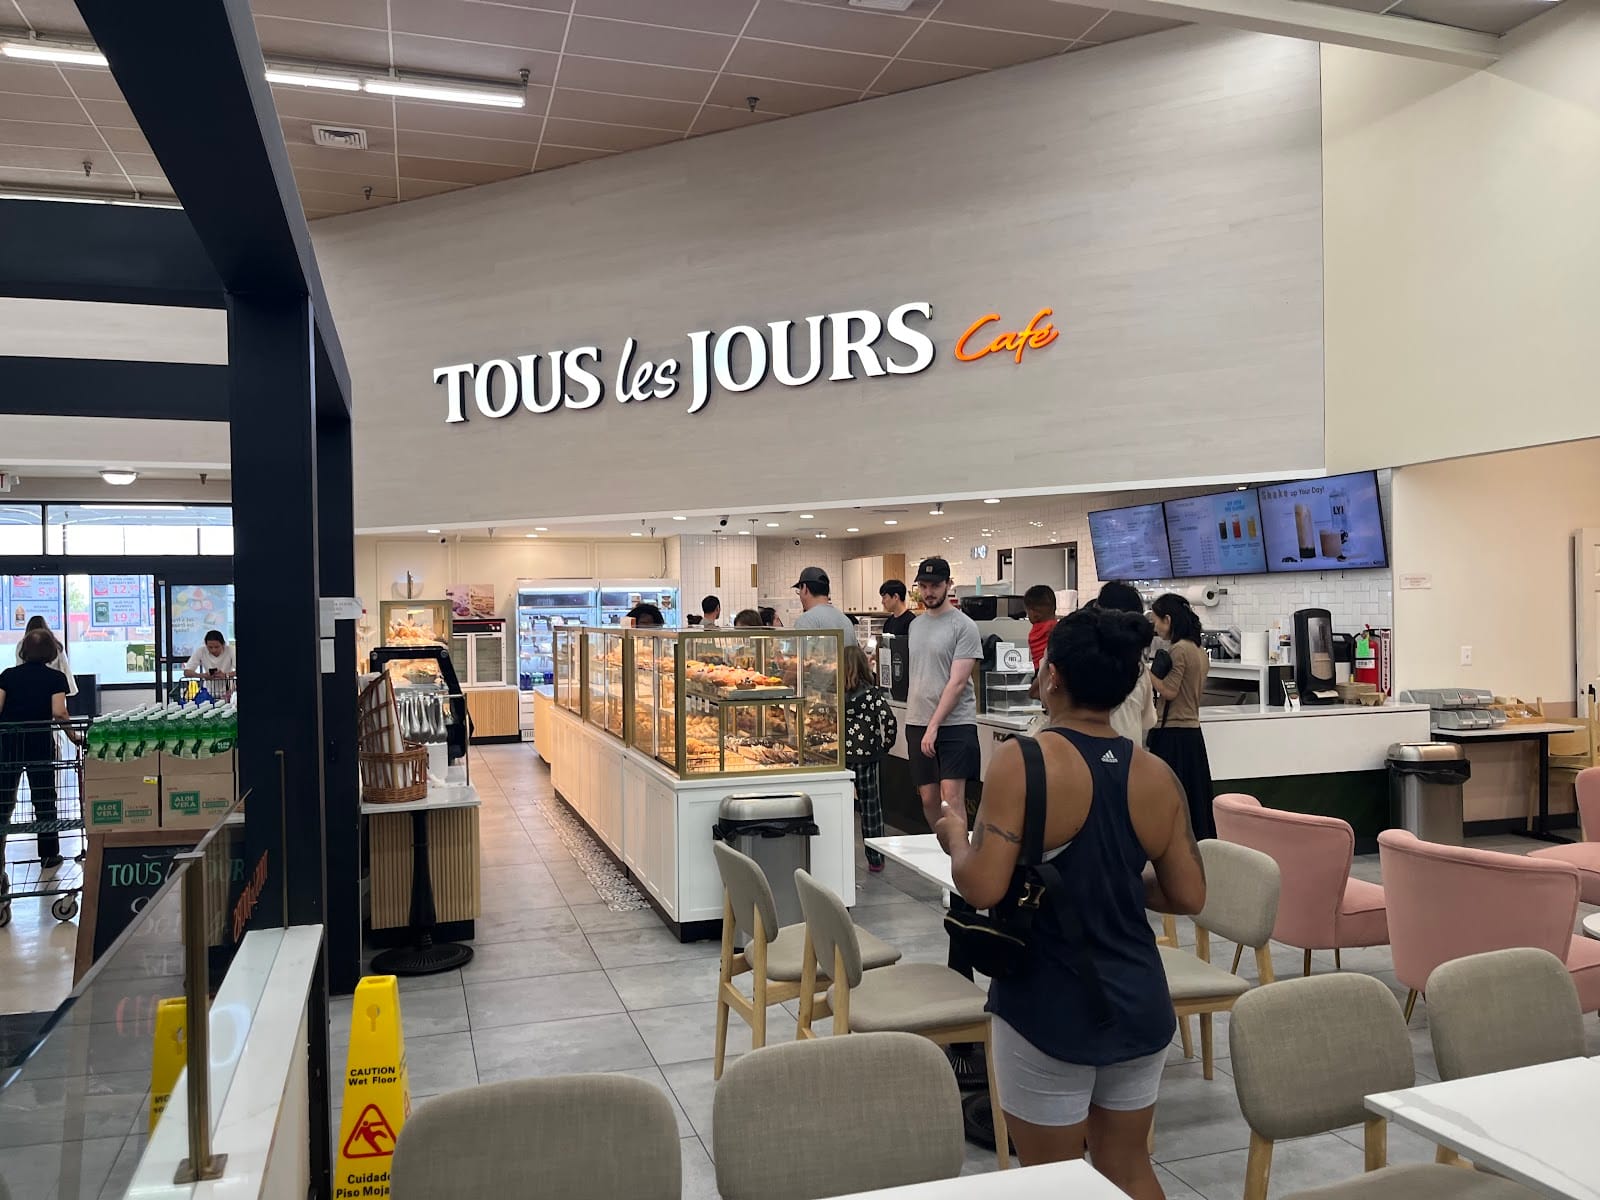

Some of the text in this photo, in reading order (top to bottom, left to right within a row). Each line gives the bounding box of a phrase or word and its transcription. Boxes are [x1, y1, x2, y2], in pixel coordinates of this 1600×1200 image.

[433, 301, 1059, 424] TOUS les JOURS Café
[1261, 488, 1288, 500] Shake
[1311, 486, 1325, 495] Day!
[96, 803, 118, 811] ALOE
[107, 861, 163, 887] TOUS
[350, 1066, 396, 1077] CAUTION
[348, 1076, 398, 1086] Wet Floor
[336, 1185, 390, 1199] Piso Moja
